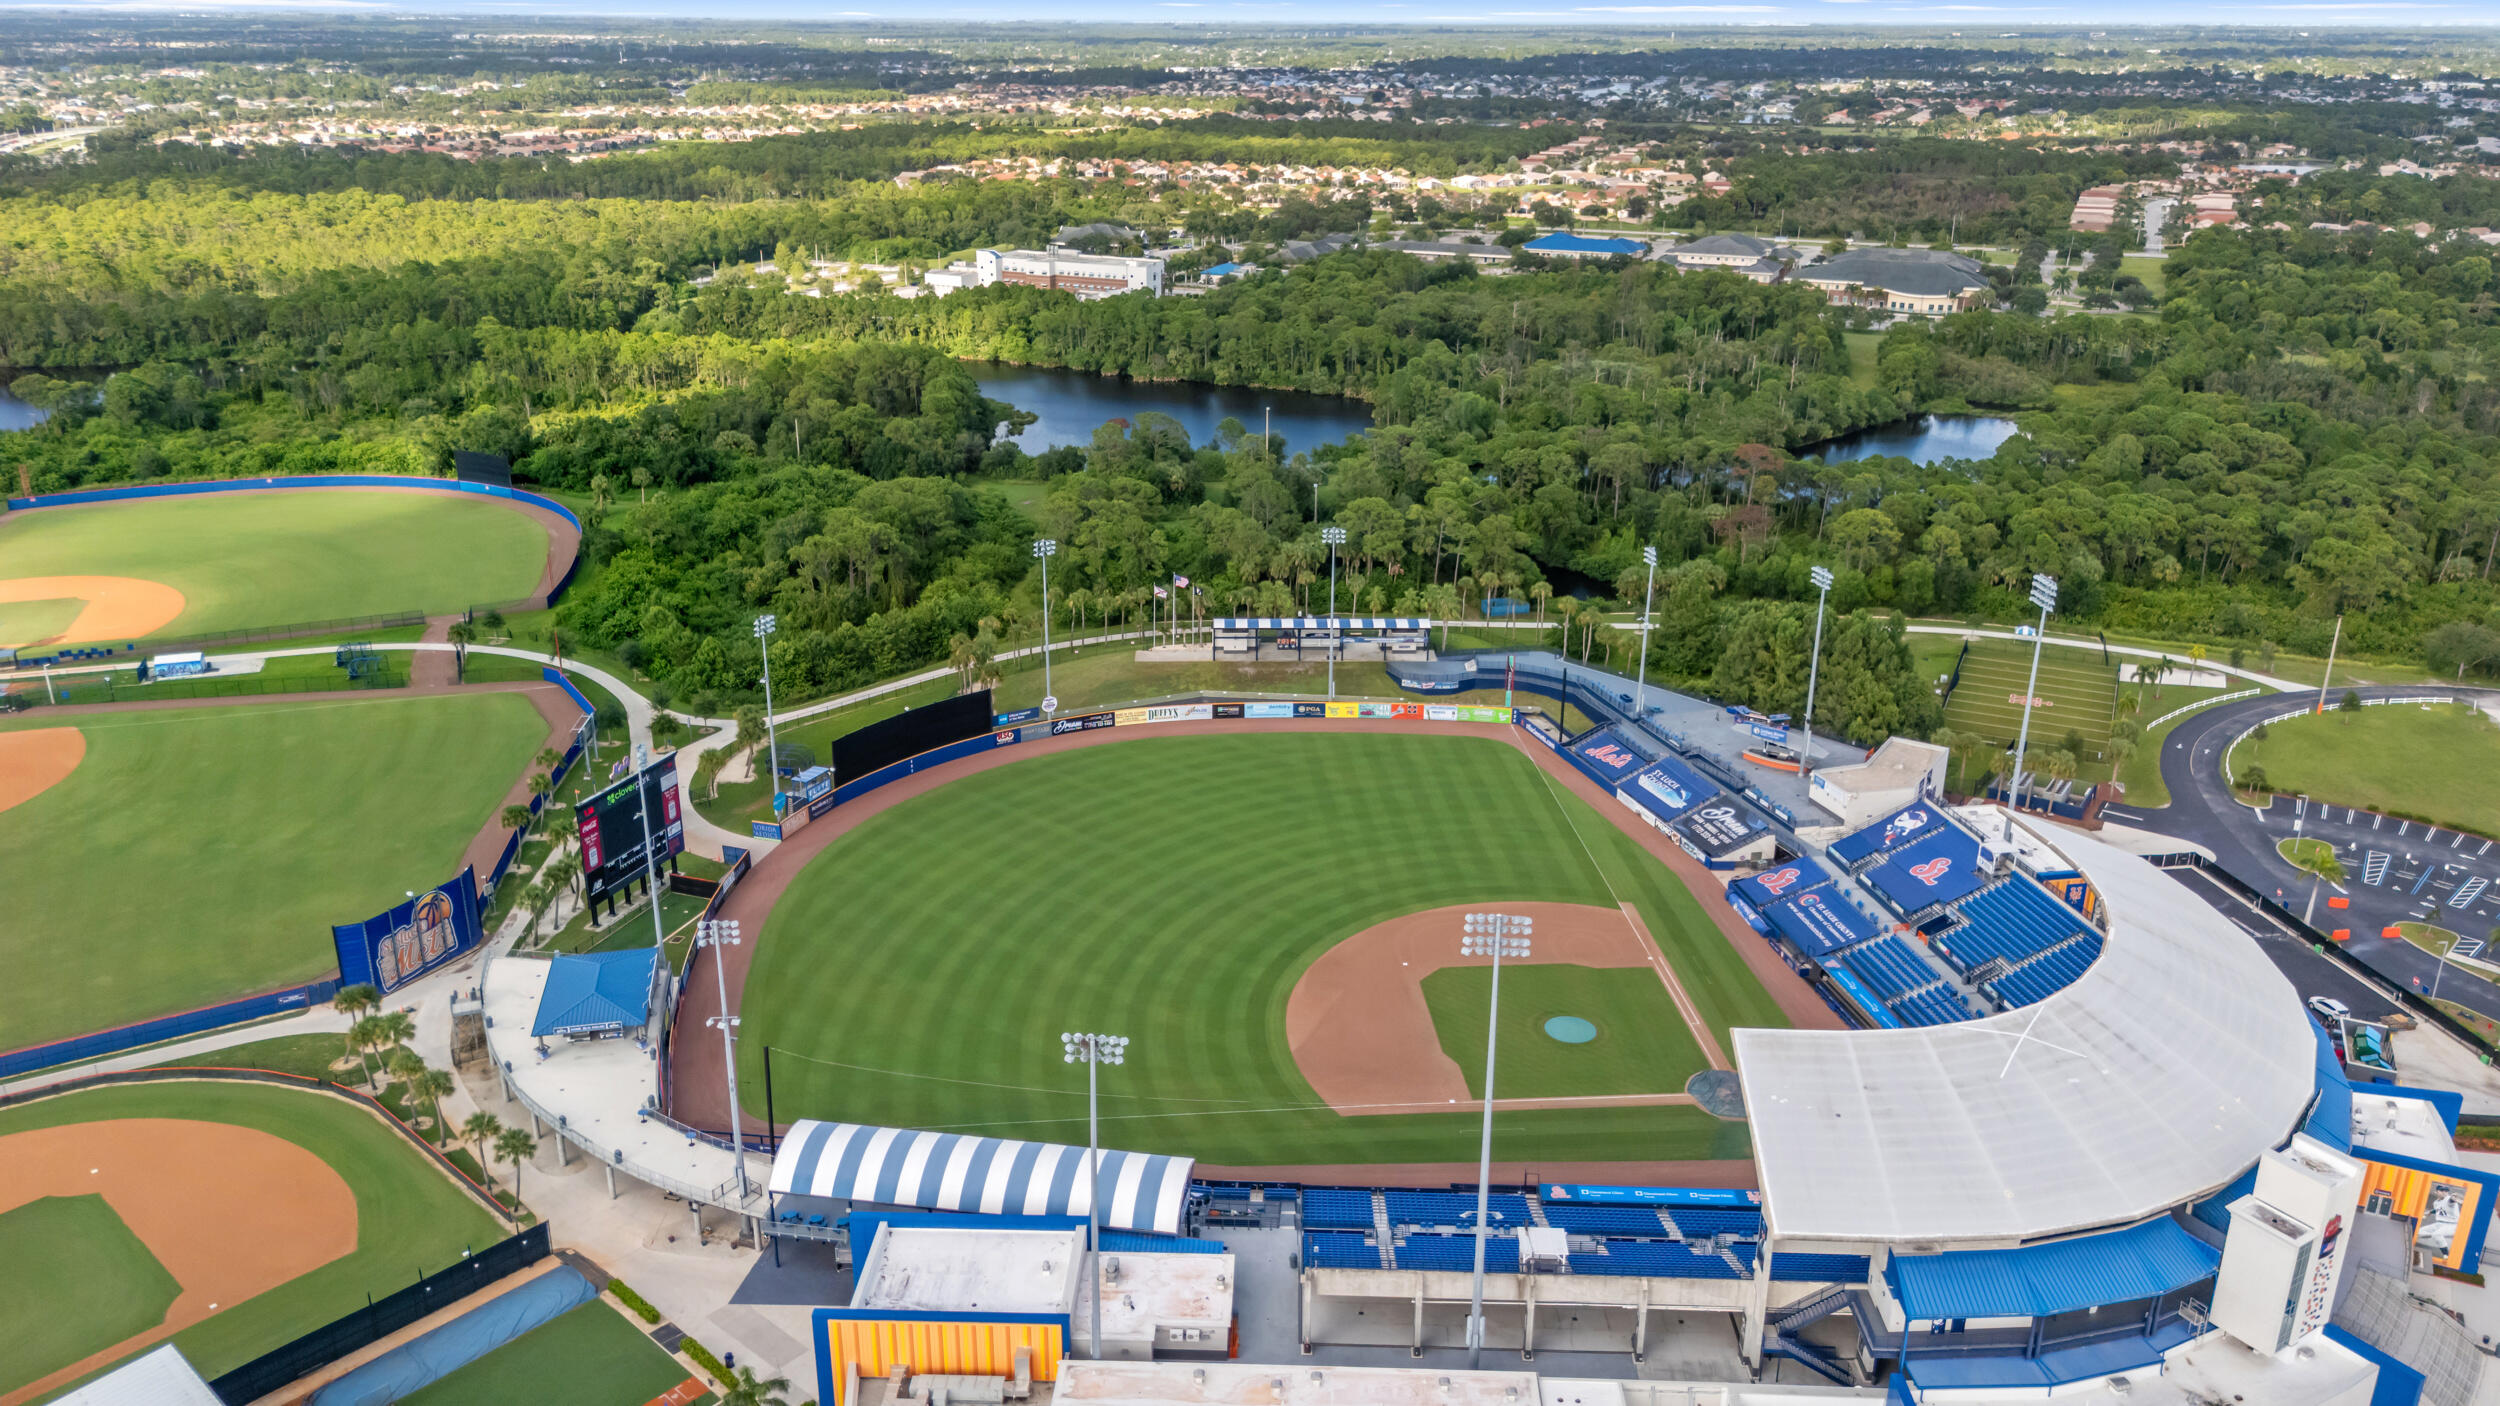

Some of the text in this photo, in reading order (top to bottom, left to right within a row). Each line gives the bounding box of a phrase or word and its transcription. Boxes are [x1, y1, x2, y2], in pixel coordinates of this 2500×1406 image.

[1585, 744, 1633, 768] Mets
[615, 774, 650, 799] clover prk
[1661, 775, 1681, 790] LUCIE
